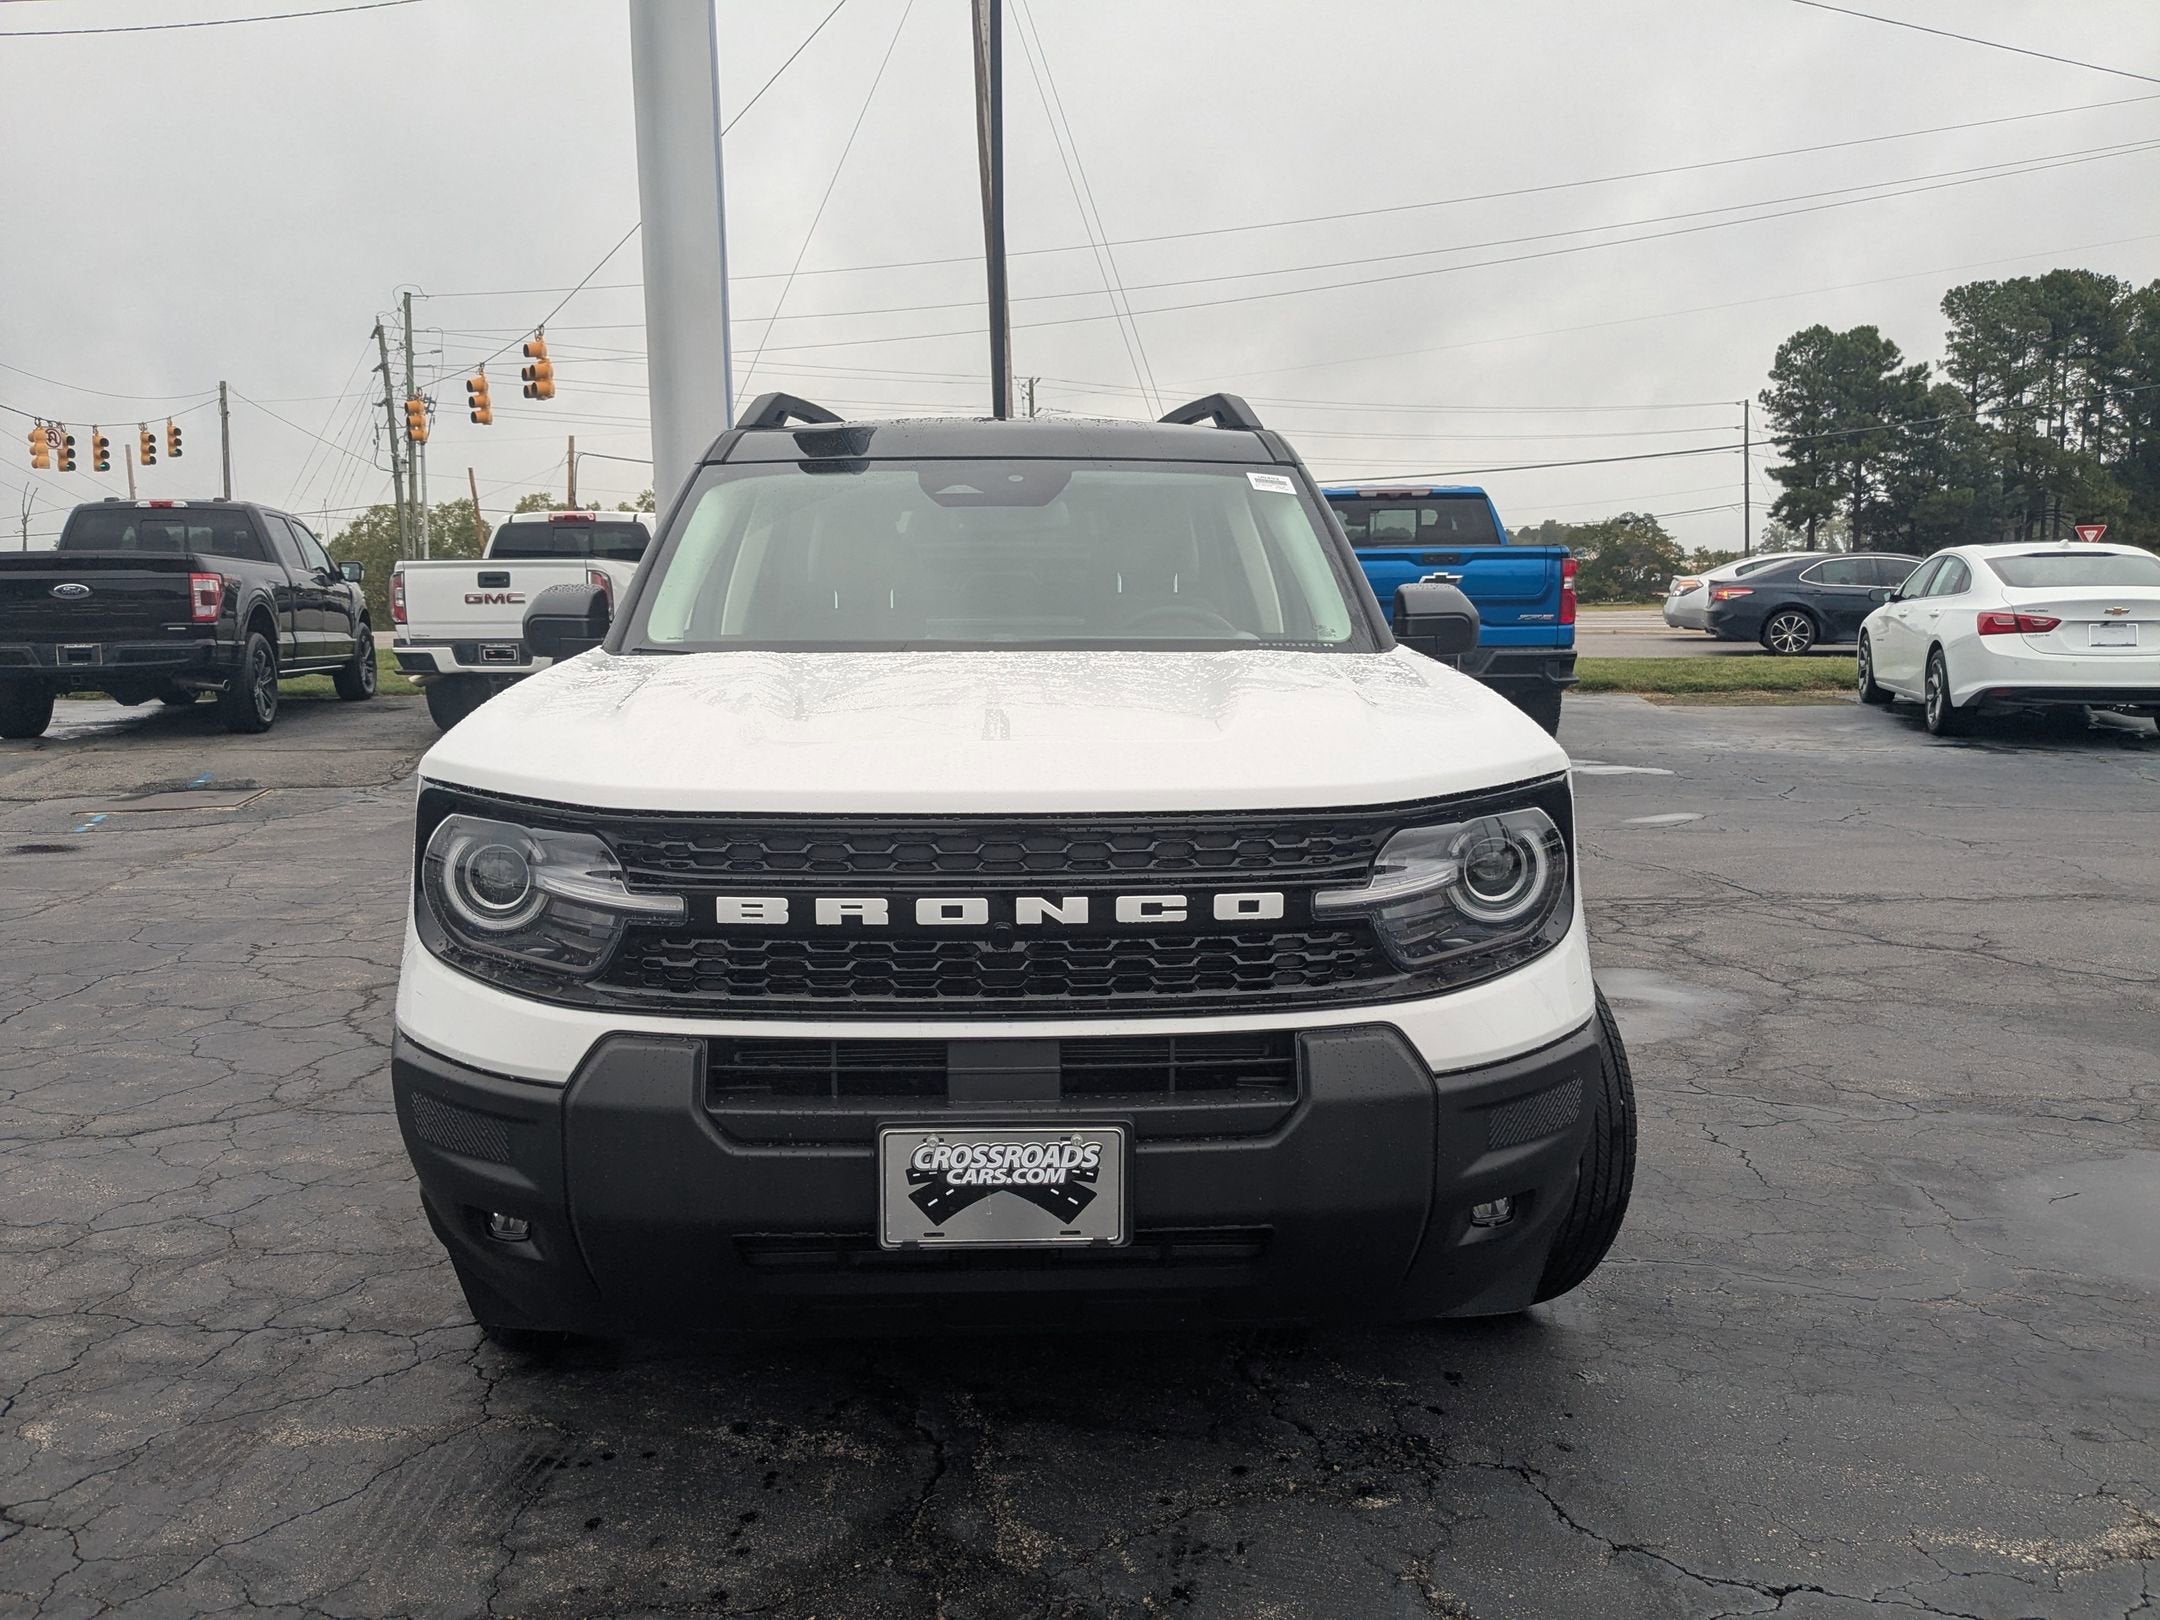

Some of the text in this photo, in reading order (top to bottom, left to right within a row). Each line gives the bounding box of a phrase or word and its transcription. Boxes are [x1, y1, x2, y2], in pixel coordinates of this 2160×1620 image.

[464, 591, 526, 604] GMC
[716, 892, 1284, 924] BRONCO
[912, 1143, 1102, 1170] CROSSROADS
[945, 1167, 1067, 1185] CARS.COM
